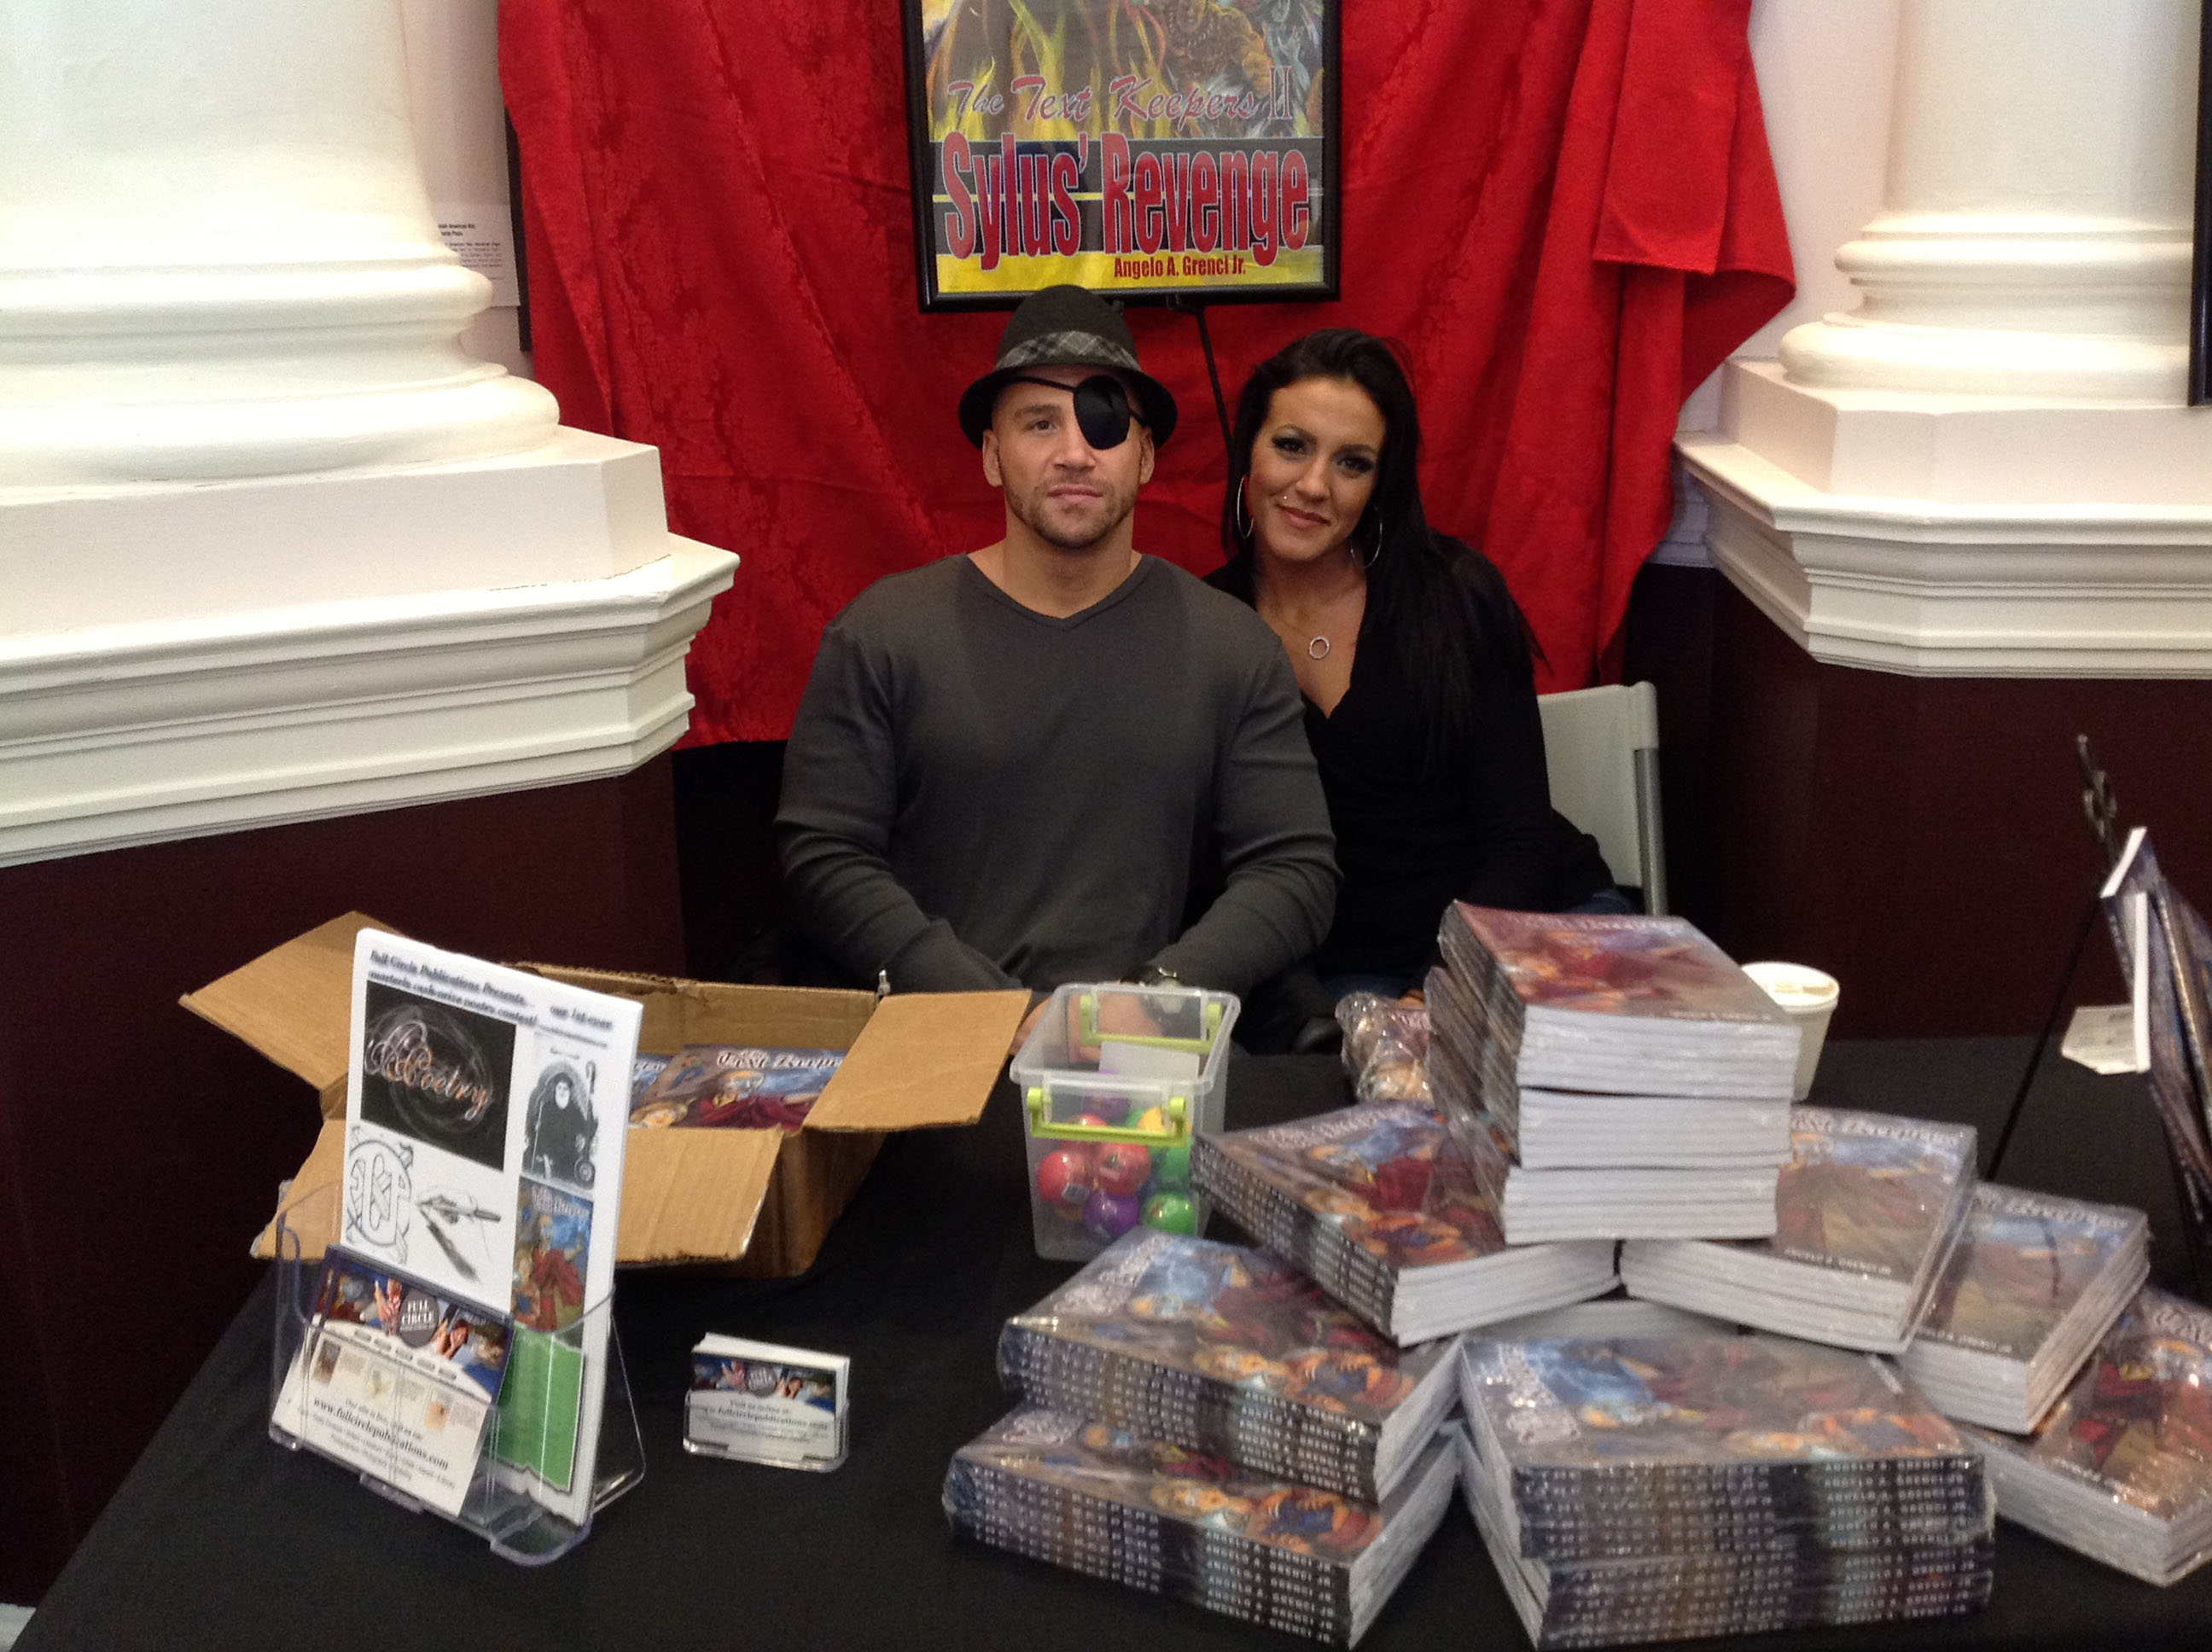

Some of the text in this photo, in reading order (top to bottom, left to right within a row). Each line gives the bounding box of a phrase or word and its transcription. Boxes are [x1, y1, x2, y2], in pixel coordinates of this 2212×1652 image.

[946, 64, 1294, 131] The Text Keepers II
[941, 131, 1311, 272] Sylus' Revenge
[1114, 257, 1164, 281] Angelo
[1167, 256, 1179, 277] A.
[1231, 254, 1247, 275] Jr.
